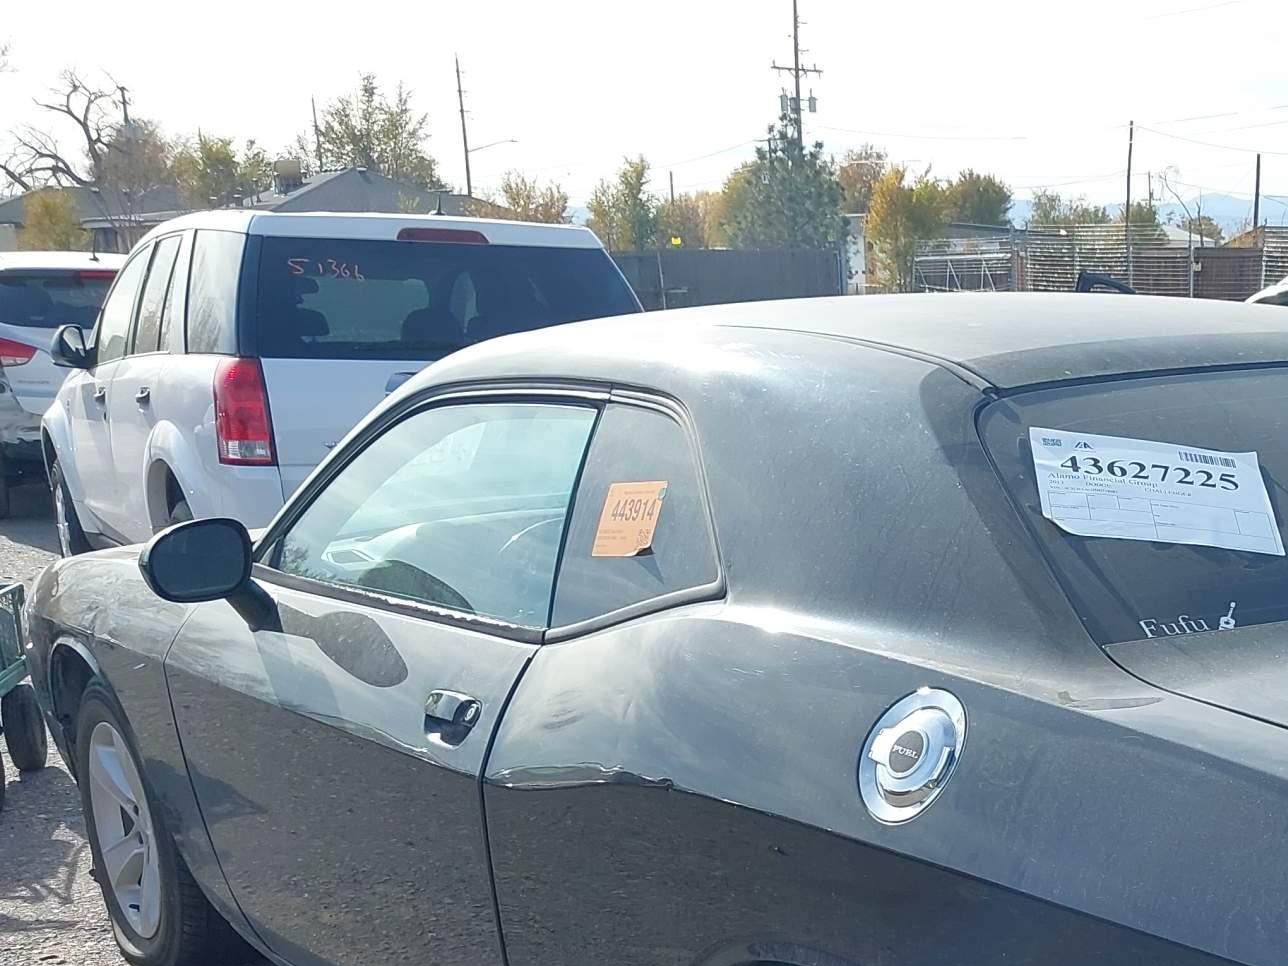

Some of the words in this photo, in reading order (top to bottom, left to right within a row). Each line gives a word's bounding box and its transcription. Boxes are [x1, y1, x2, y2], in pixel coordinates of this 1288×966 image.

[1060, 455, 1239, 491] 43627225
[612, 499, 655, 521] 443914
[1139, 615, 1210, 638] Fufu
